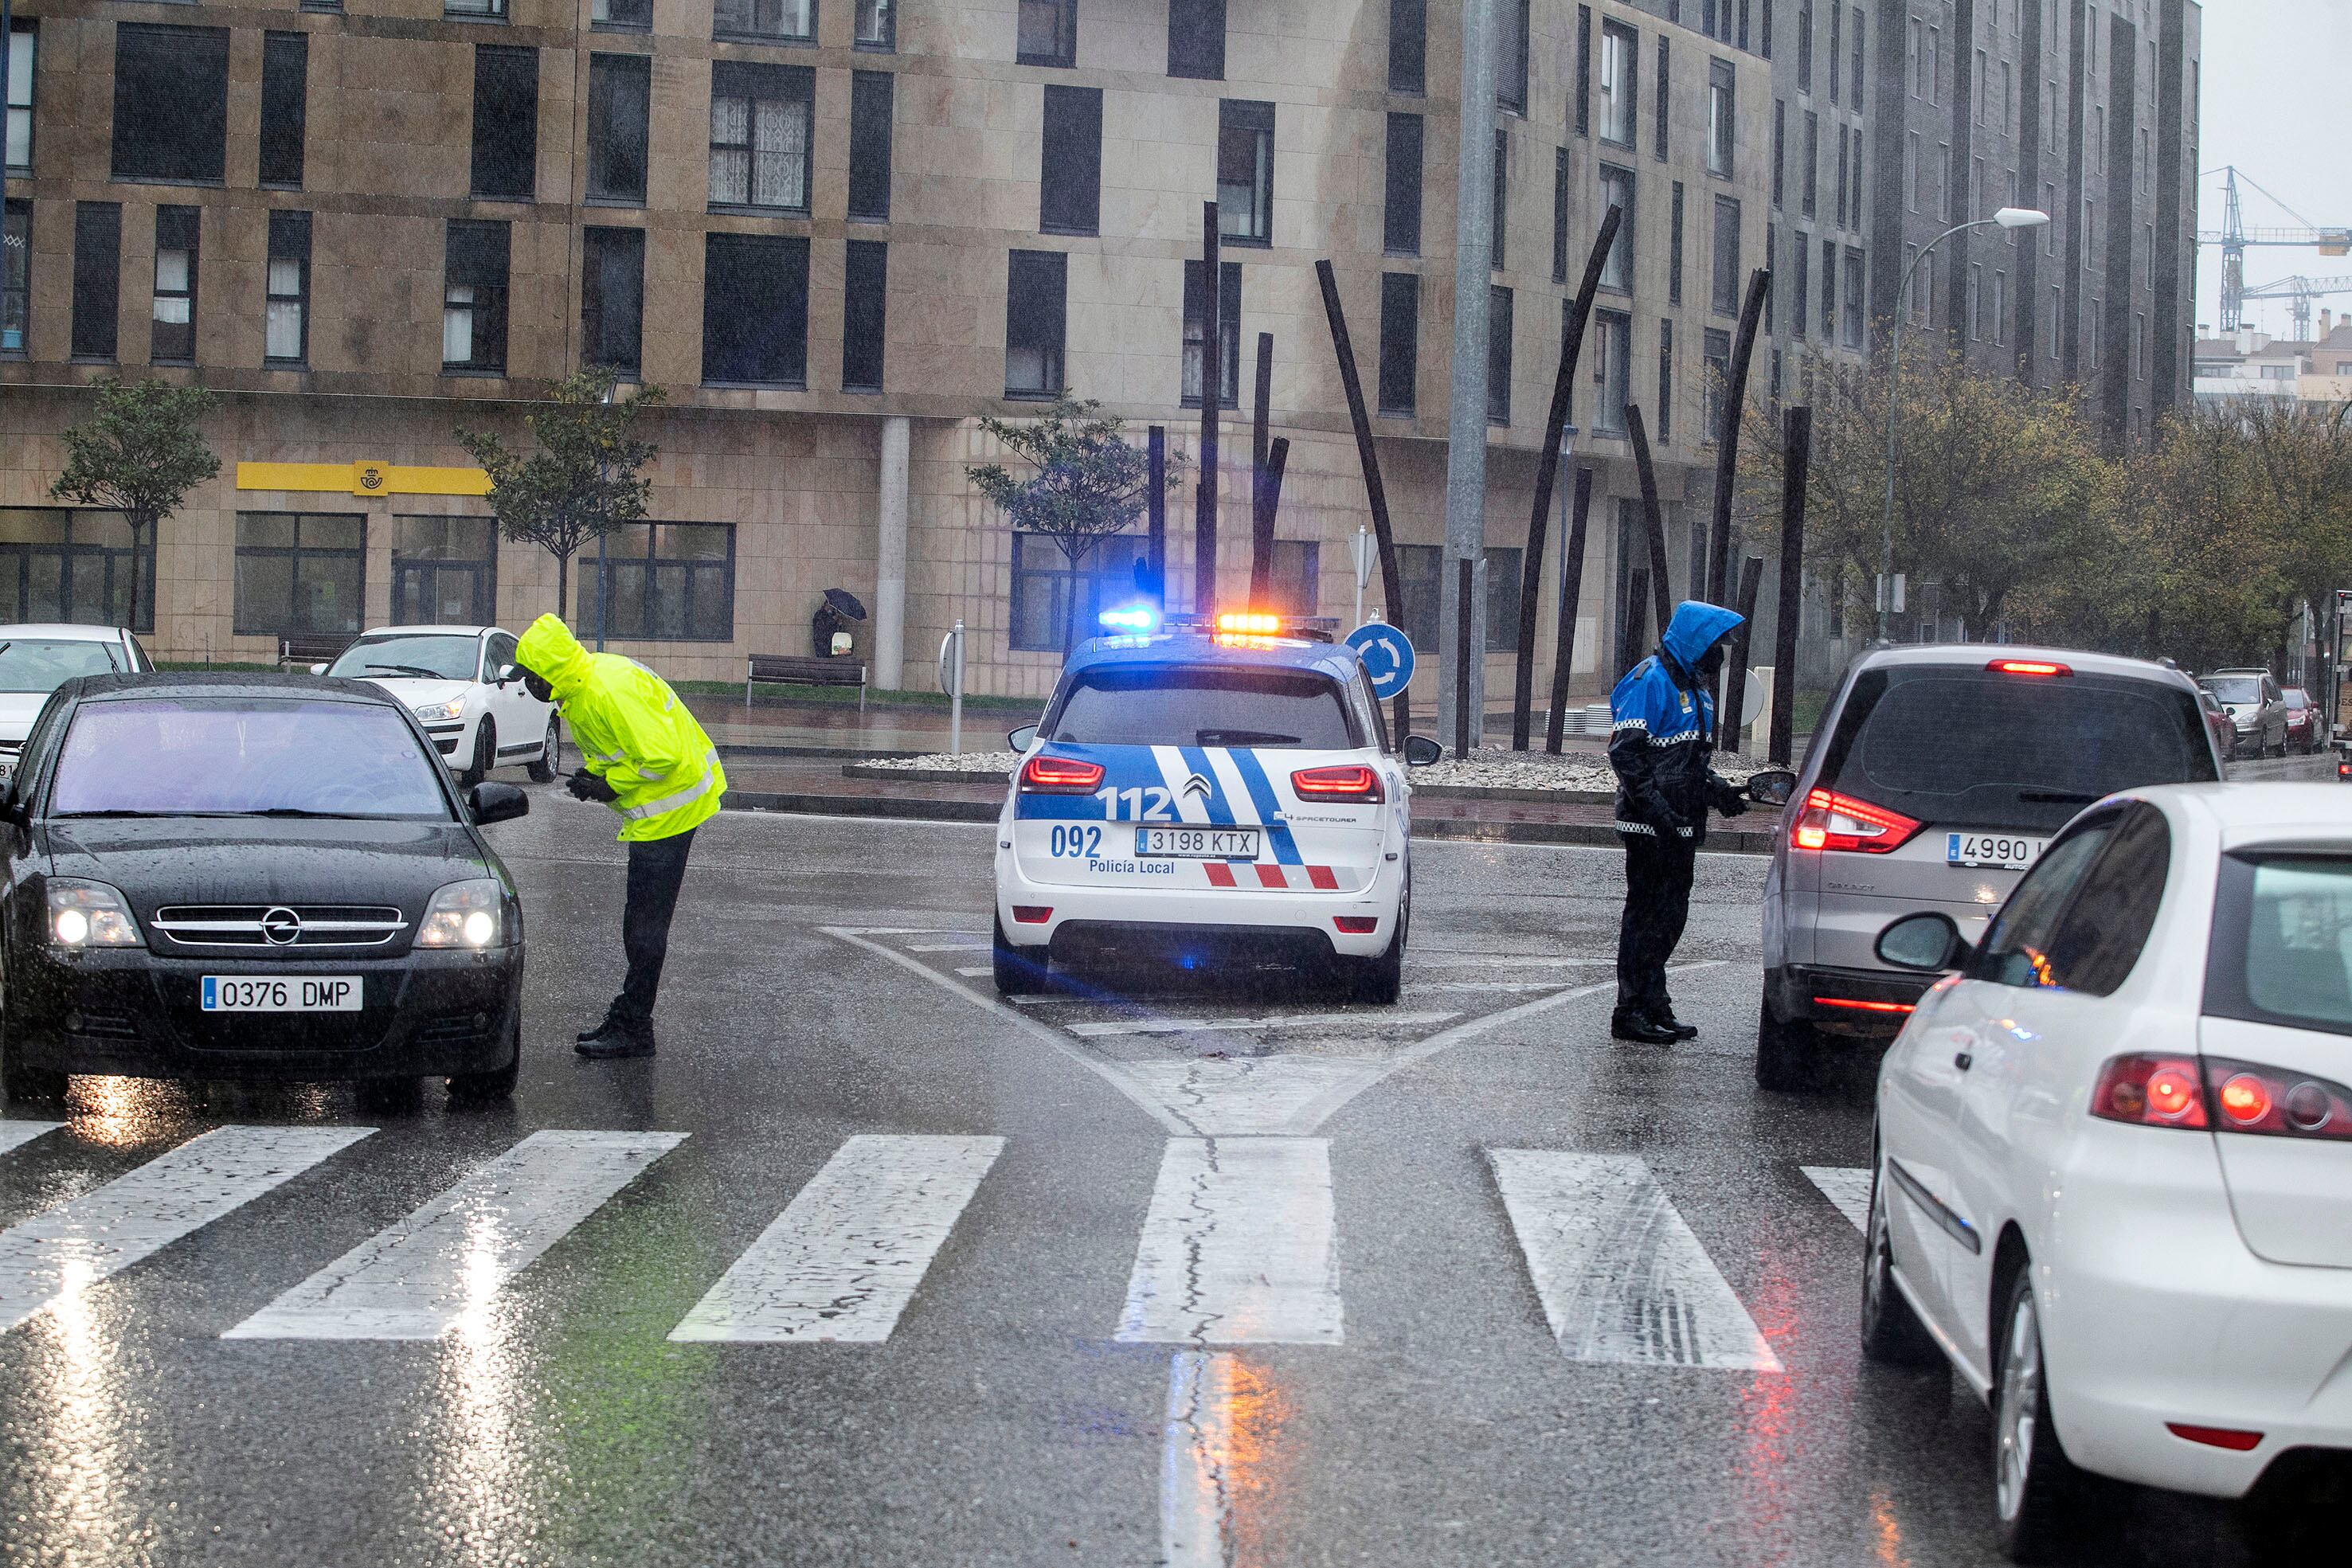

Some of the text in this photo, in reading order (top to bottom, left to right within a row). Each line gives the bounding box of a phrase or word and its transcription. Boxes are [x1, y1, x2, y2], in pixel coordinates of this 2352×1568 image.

[1094, 786, 1172, 821] 112
[1051, 824, 1102, 858] 092
[1153, 831, 1250, 852] 3198 KTX
[1964, 837, 2027, 861] 4990
[1090, 859, 1174, 874] Policía Local
[223, 982, 350, 1007] 0376 DMP
